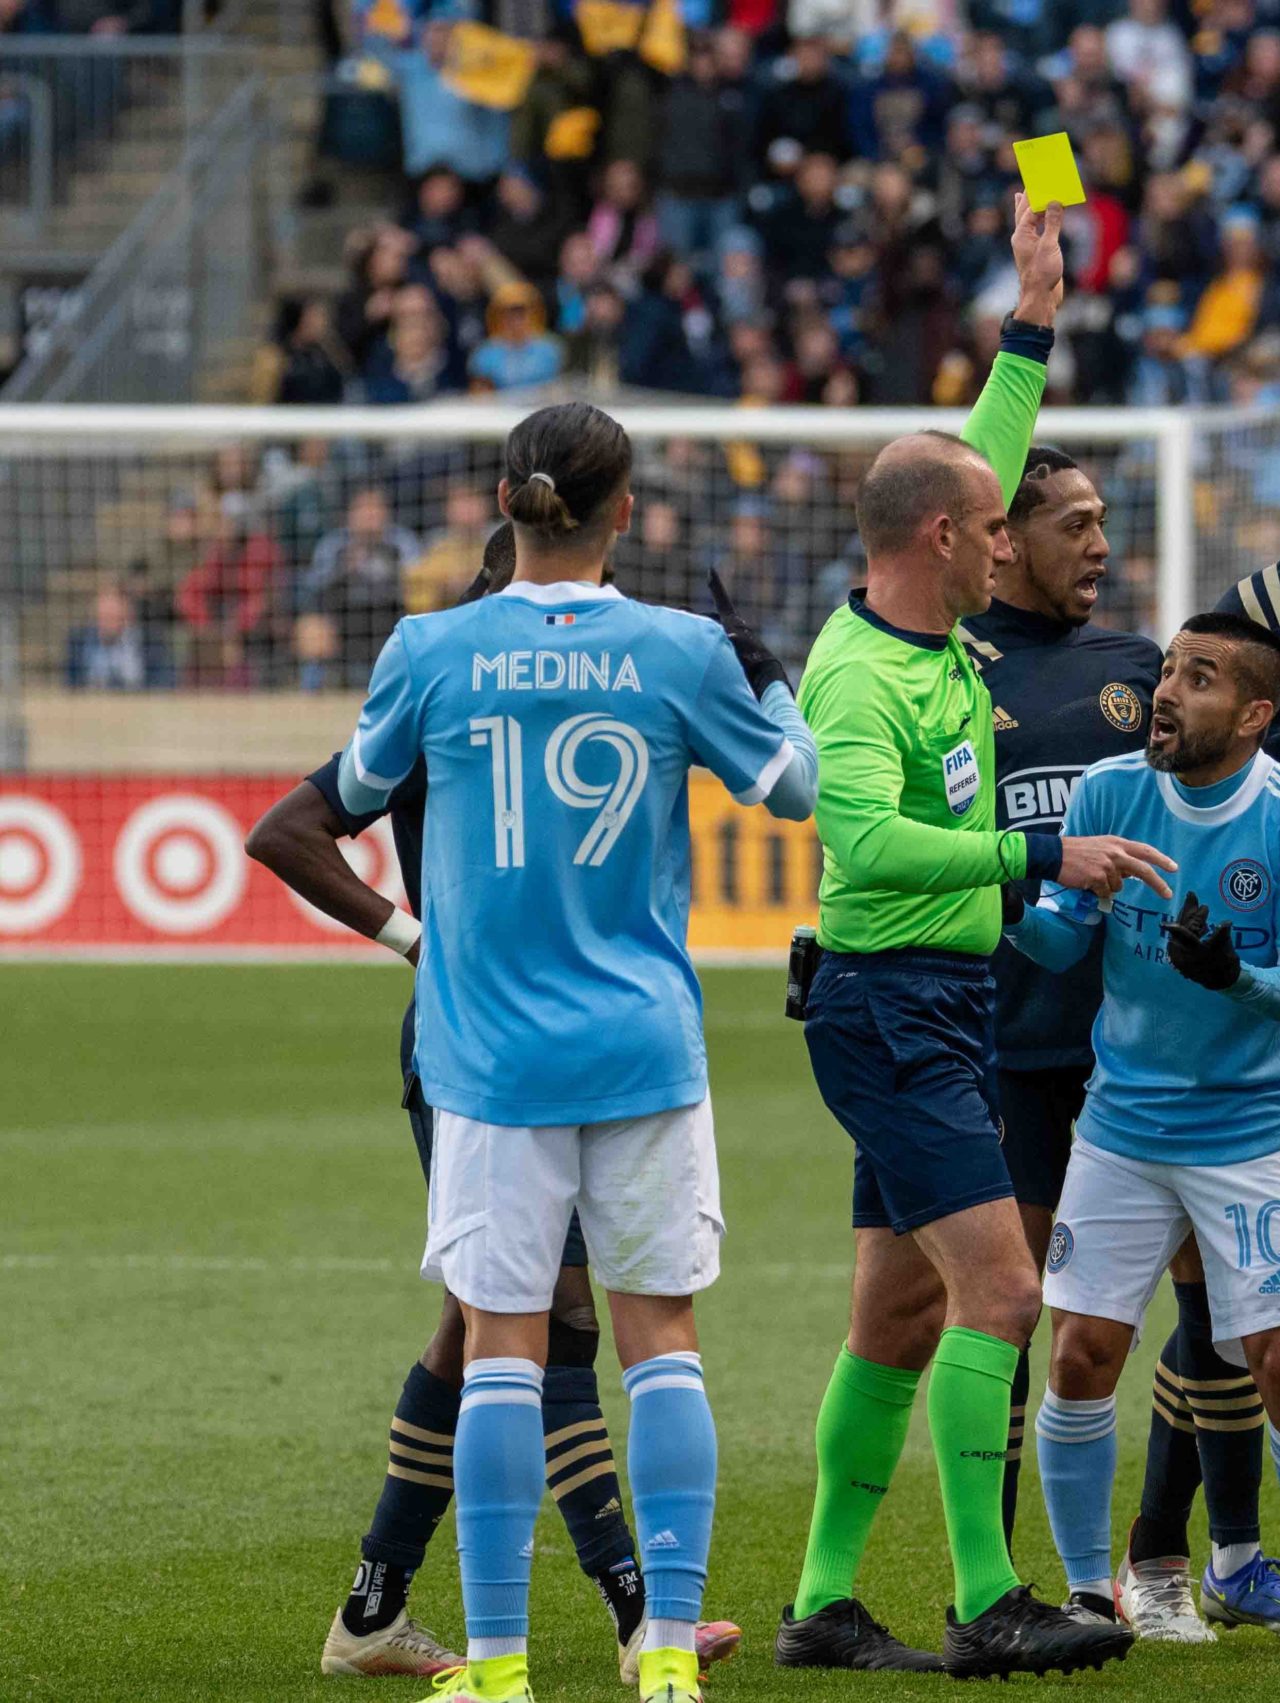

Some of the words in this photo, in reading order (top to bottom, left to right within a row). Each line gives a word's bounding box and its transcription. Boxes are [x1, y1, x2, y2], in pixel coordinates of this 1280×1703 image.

[472, 651, 643, 693] MEDINA
[994, 719, 1020, 732] idas
[945, 747, 972, 776] FIFA
[470, 712, 650, 869] 19
[949, 772, 977, 796] REFEREE
[1004, 776, 1078, 819] BIM
[618, 1572, 639, 1588] JM
[625, 1583, 637, 1597] 10
